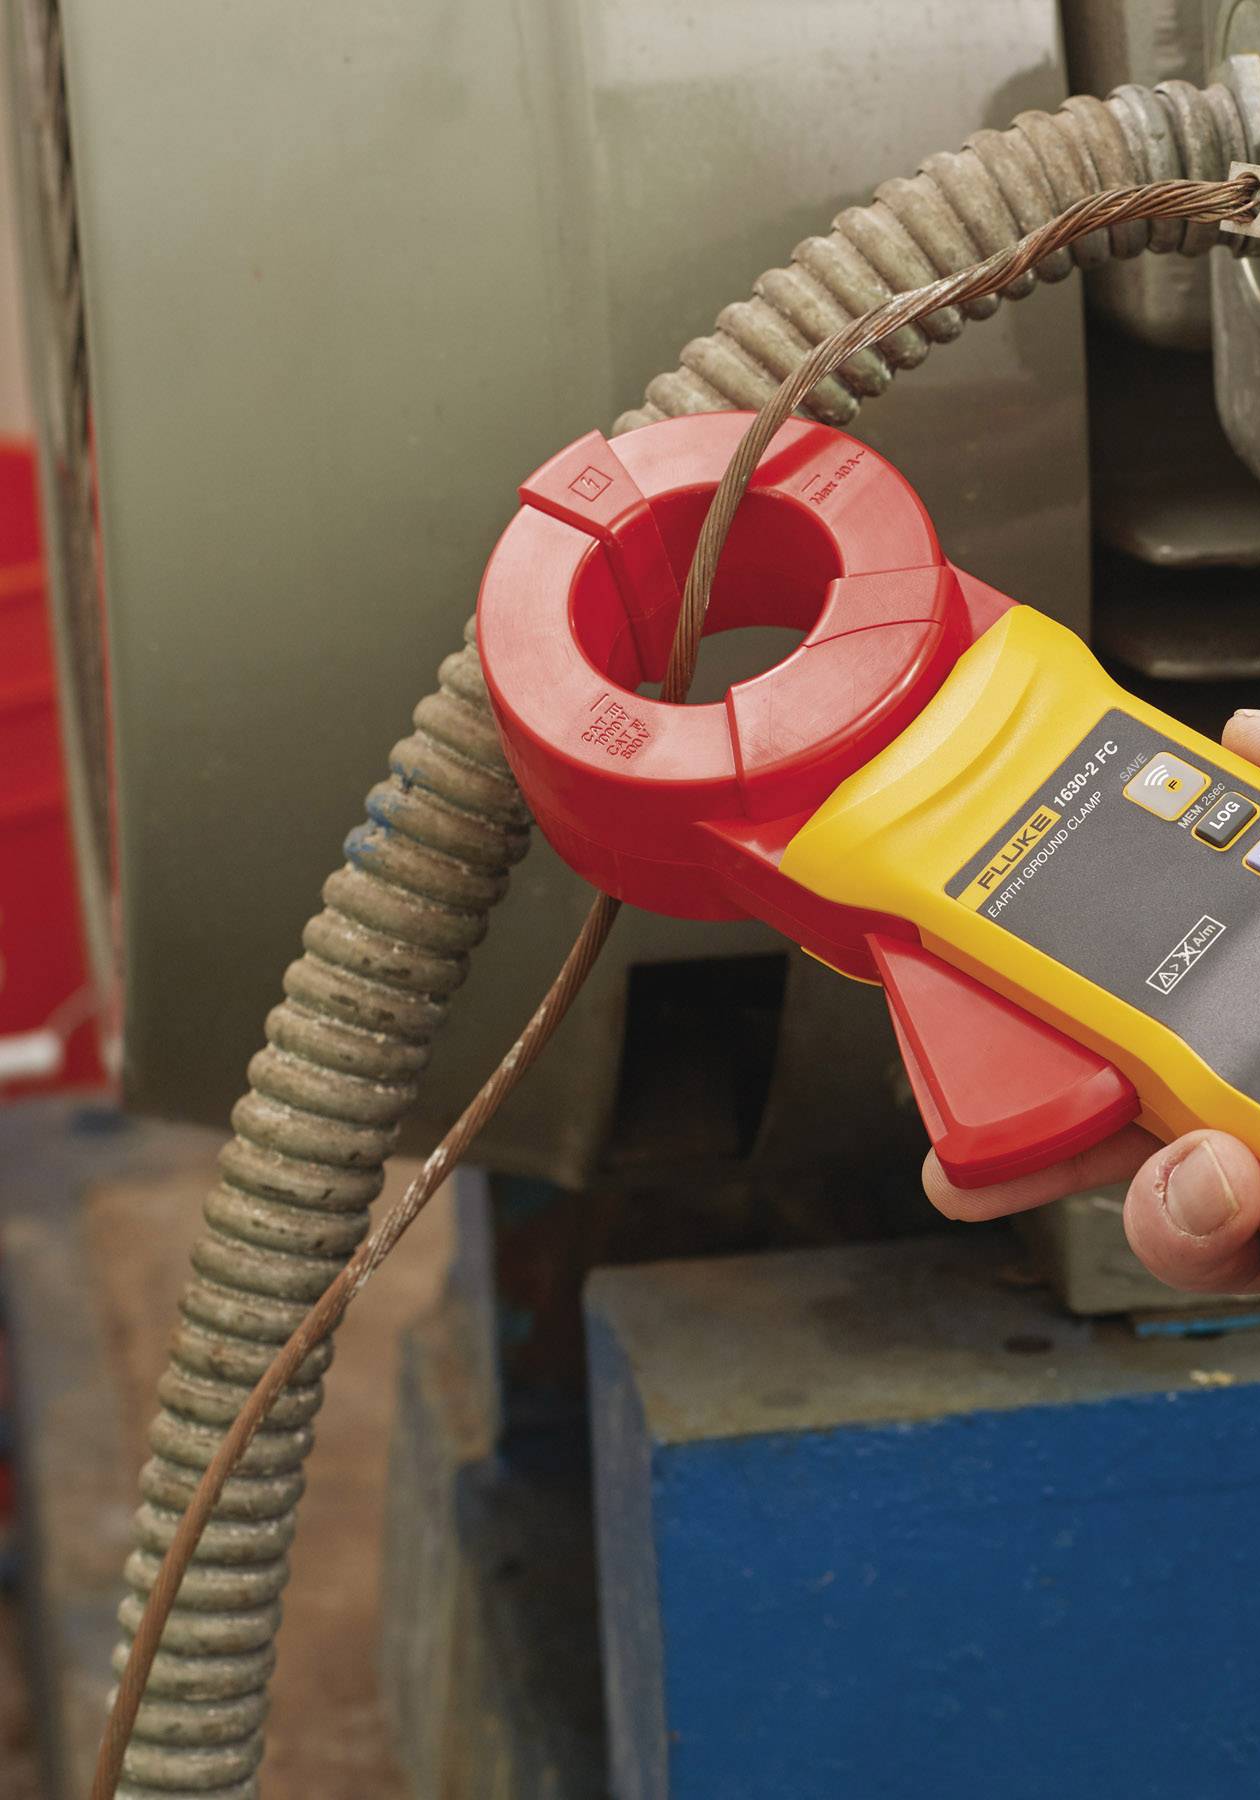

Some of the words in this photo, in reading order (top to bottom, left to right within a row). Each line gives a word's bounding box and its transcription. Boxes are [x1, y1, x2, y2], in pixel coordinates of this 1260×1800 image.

[581, 716, 607, 742] CAT
[594, 711, 630, 746] 1000V
[606, 730, 632, 756] CAT
[1119, 752, 1148, 782] SAVE
[977, 813, 1052, 890] FLUKE
[1054, 761, 1099, 807] 1630-2
[1094, 740, 1118, 764] FC
[1177, 804, 1204, 829] MEM
[1201, 782, 1226, 806] 2sec
[1209, 801, 1240, 830] LOG
[987, 877, 1025, 918] EARTH
[1023, 829, 1069, 879] GROUND
[1066, 791, 1103, 830] CLAMP
[1193, 924, 1216, 948] A/m
